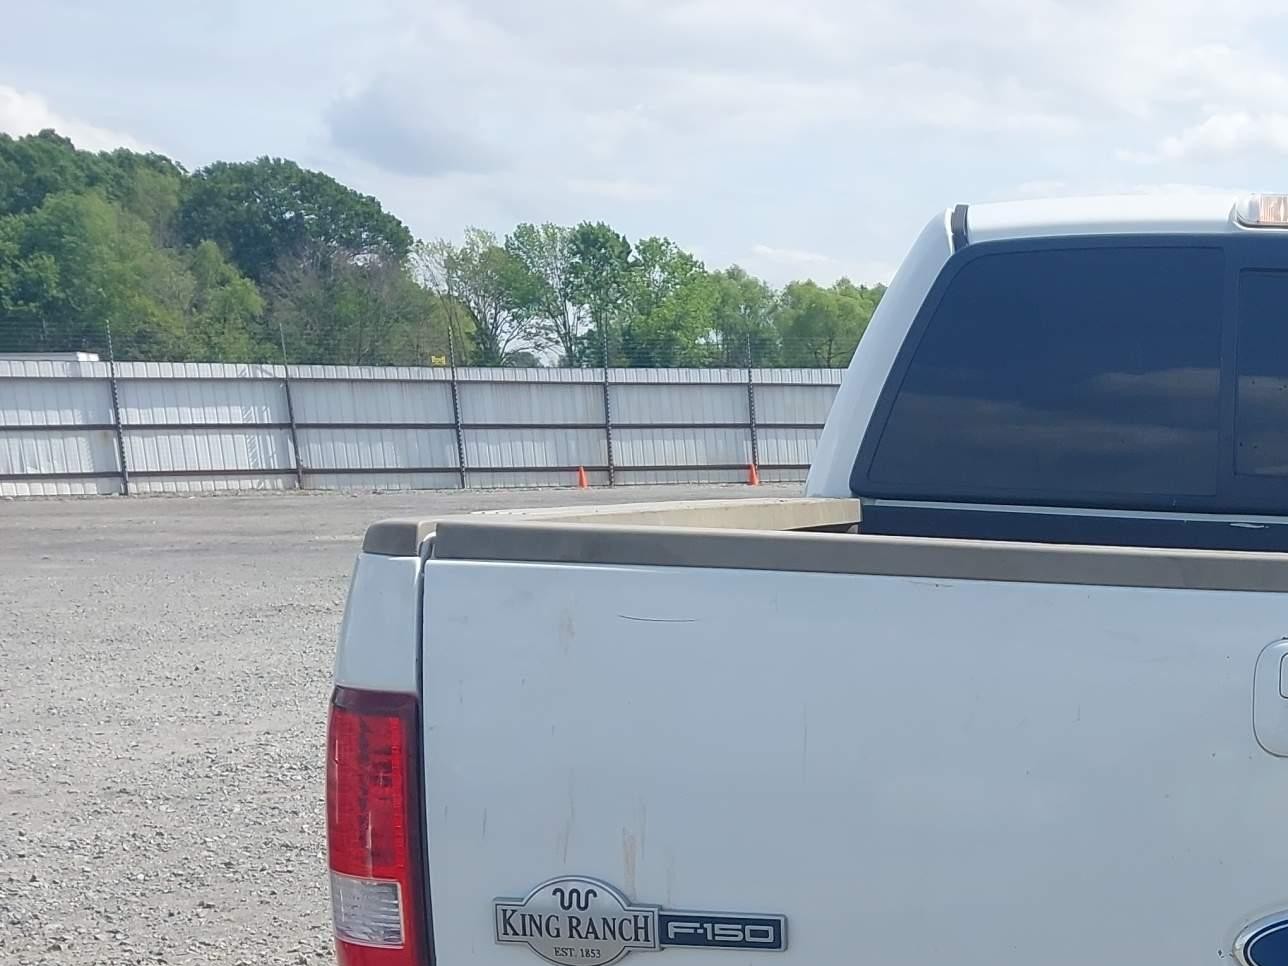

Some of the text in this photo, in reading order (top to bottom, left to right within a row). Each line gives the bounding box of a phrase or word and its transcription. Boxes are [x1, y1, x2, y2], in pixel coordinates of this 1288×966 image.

[501, 909, 651, 942] KING RANCH
[667, 921, 775, 943] F-150
[554, 947, 601, 959] EST. 1853
